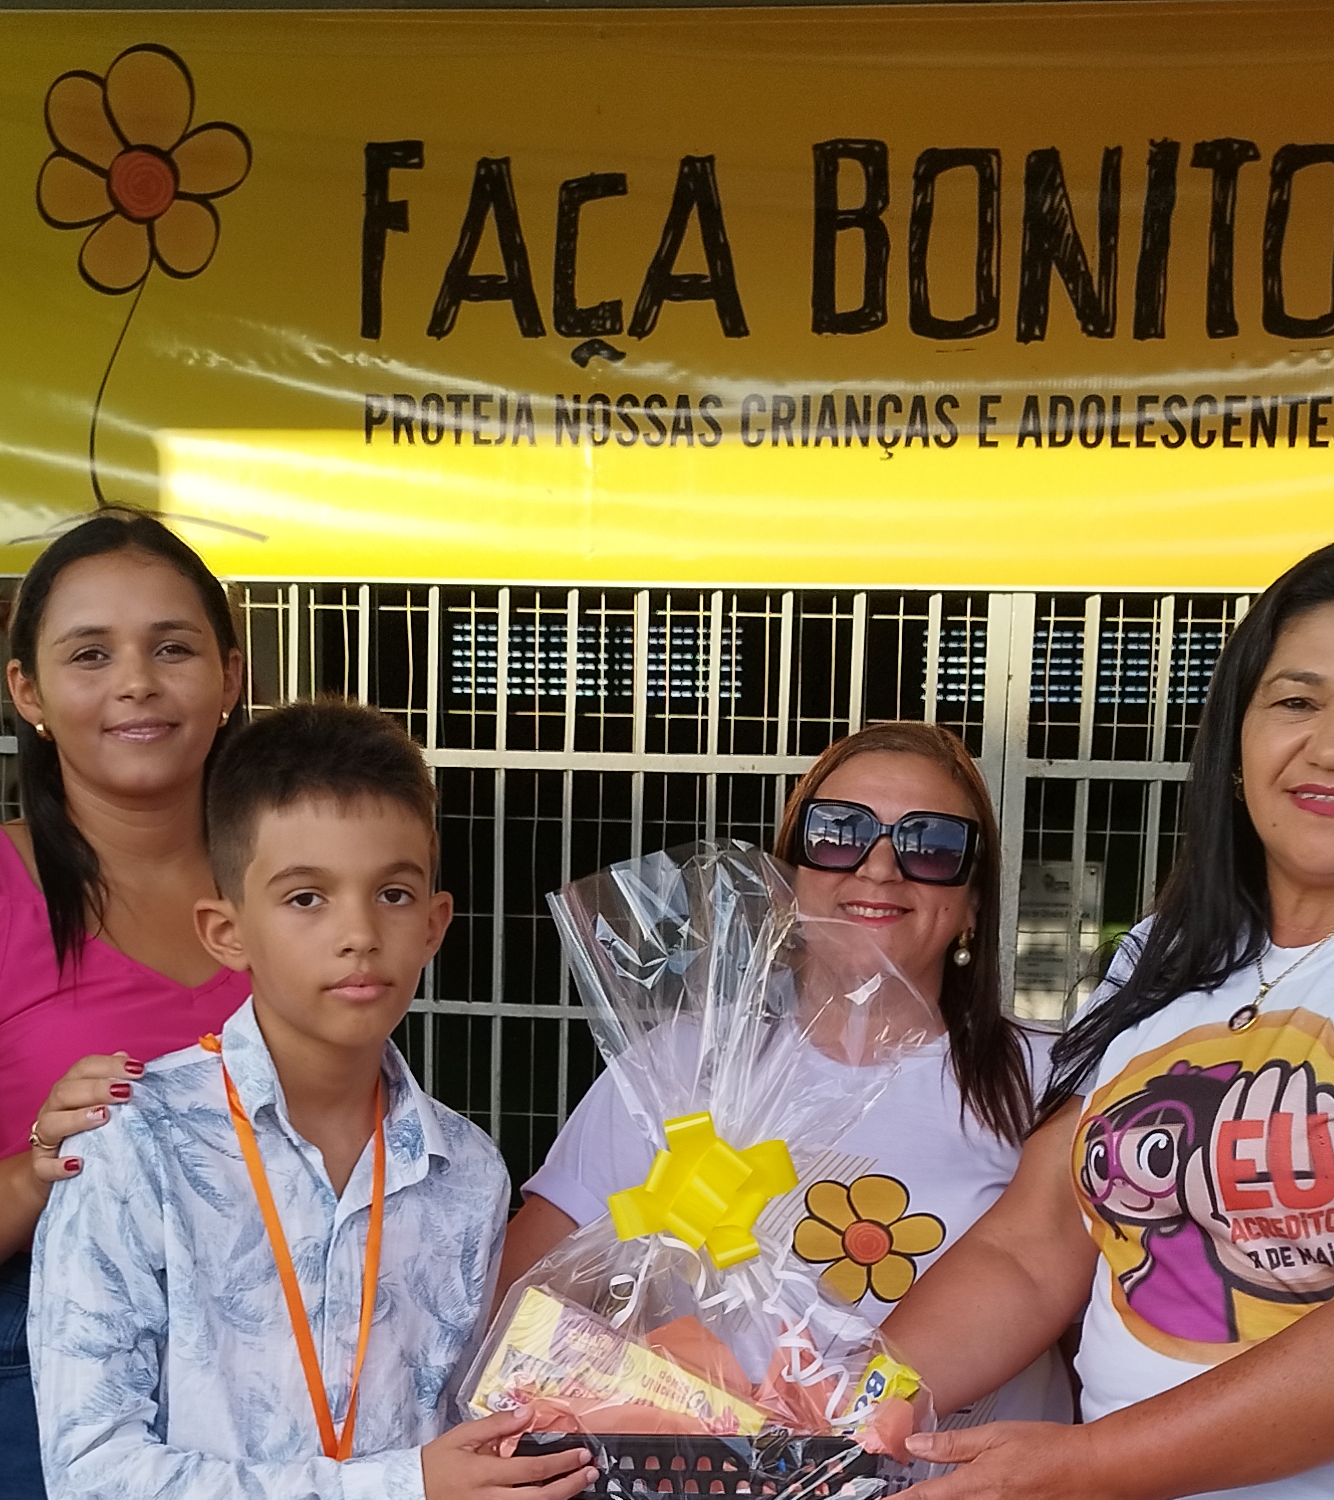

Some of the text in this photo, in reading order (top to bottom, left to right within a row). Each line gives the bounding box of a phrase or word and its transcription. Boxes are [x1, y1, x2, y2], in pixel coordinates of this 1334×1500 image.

[361, 139, 749, 367] FAÇA
[364, 393, 538, 447] PROTEJA
[553, 393, 723, 448] NOSSAS
[740, 393, 959, 460] CRIANÇAS
[978, 394, 999, 448] E
[1265, 1246, 1295, 1270] DE
